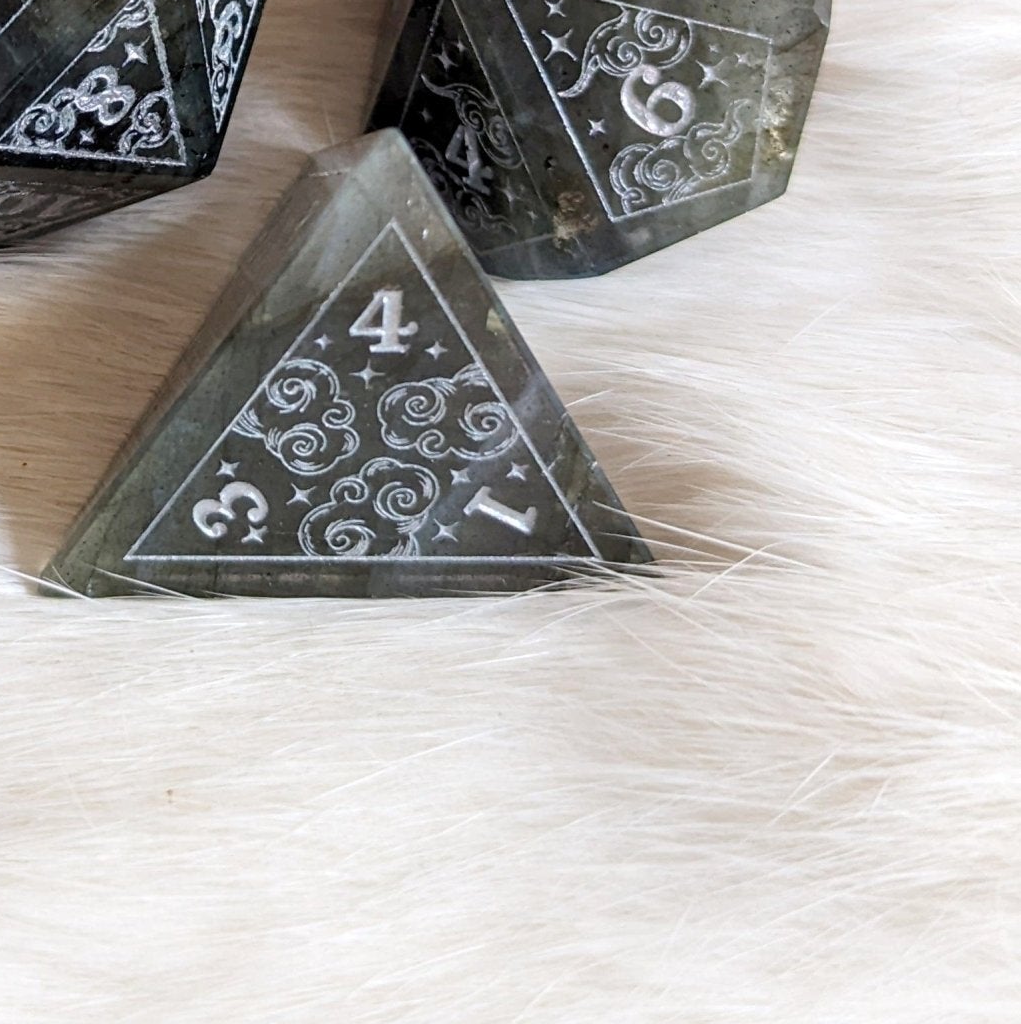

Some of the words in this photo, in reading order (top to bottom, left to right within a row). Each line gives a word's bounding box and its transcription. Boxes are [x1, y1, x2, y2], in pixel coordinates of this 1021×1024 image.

[75, 65, 136, 126] 8
[620, 64, 696, 136] 6
[349, 290, 418, 353] 4
[192, 482, 269, 538] 3
[463, 486, 537, 535] 1
